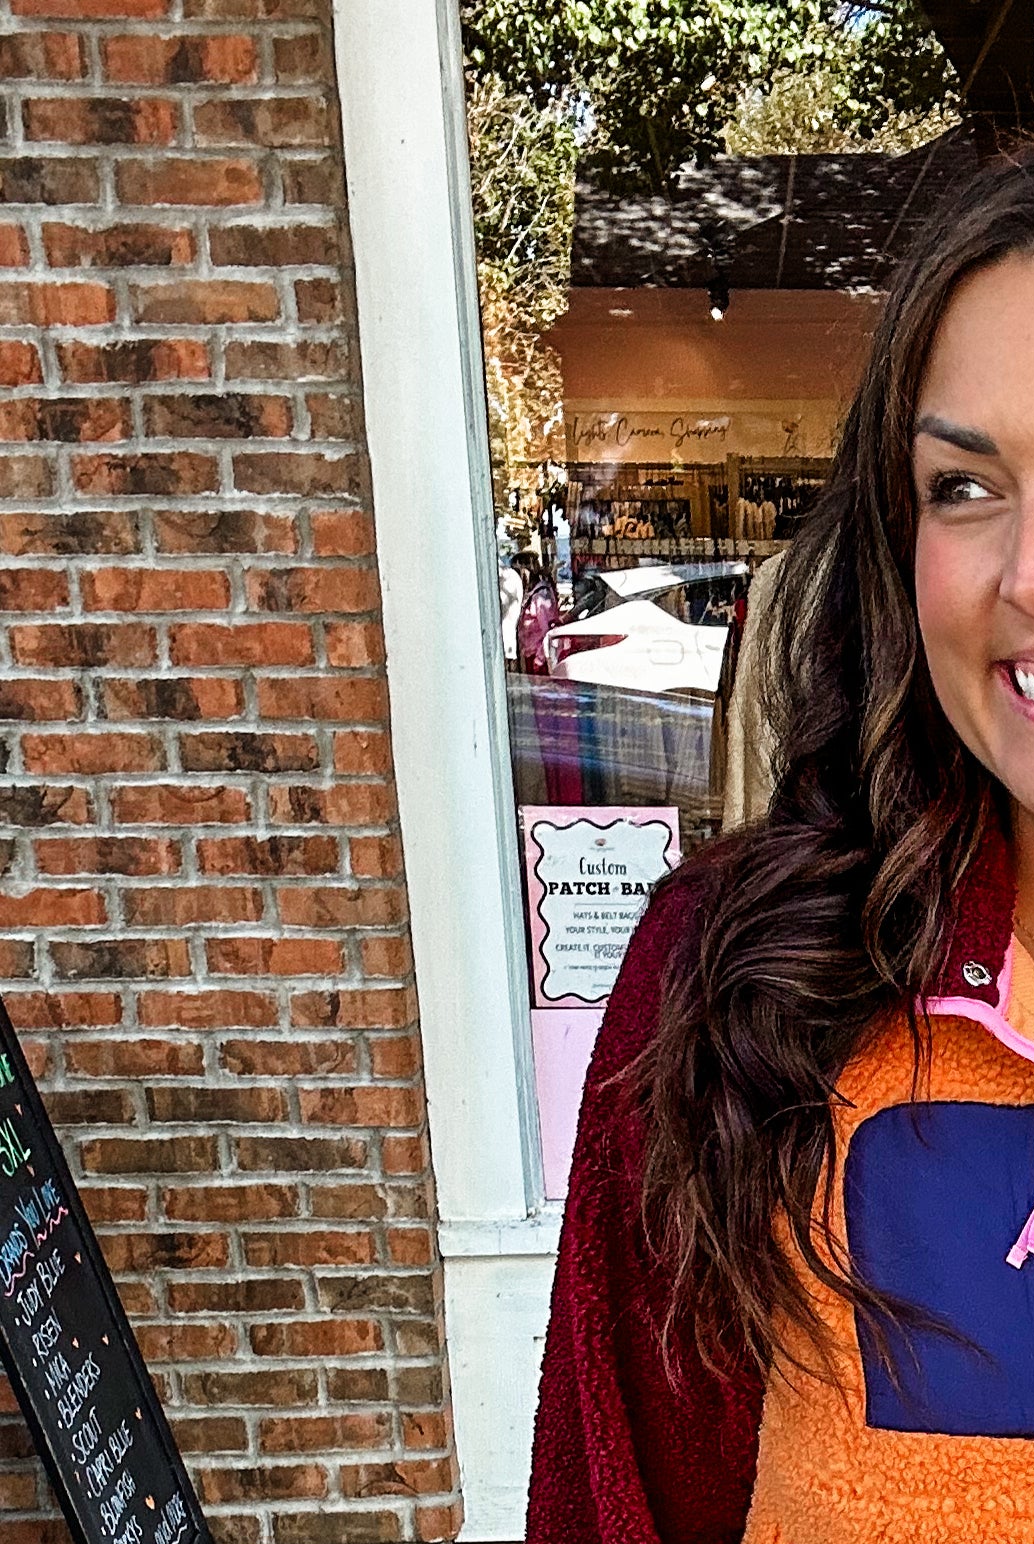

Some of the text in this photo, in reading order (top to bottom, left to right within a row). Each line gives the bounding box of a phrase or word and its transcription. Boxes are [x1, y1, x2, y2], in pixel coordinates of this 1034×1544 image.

[579, 856, 627, 876] Custom
[548, 882, 611, 896] PATCH
[566, 926, 585, 934] YOUR
[573, 911, 592, 920] HATS
[601, 911, 617, 920] BELT
[555, 944, 582, 952] CREATE
[36, 1247, 66, 1299] BLUE
[32, 1306, 62, 1365] RISEN
[57, 1351, 101, 1430] BLENDERS
[72, 1405, 103, 1465] SCOUT
[85, 1418, 134, 1498] CAPRI BLUE
